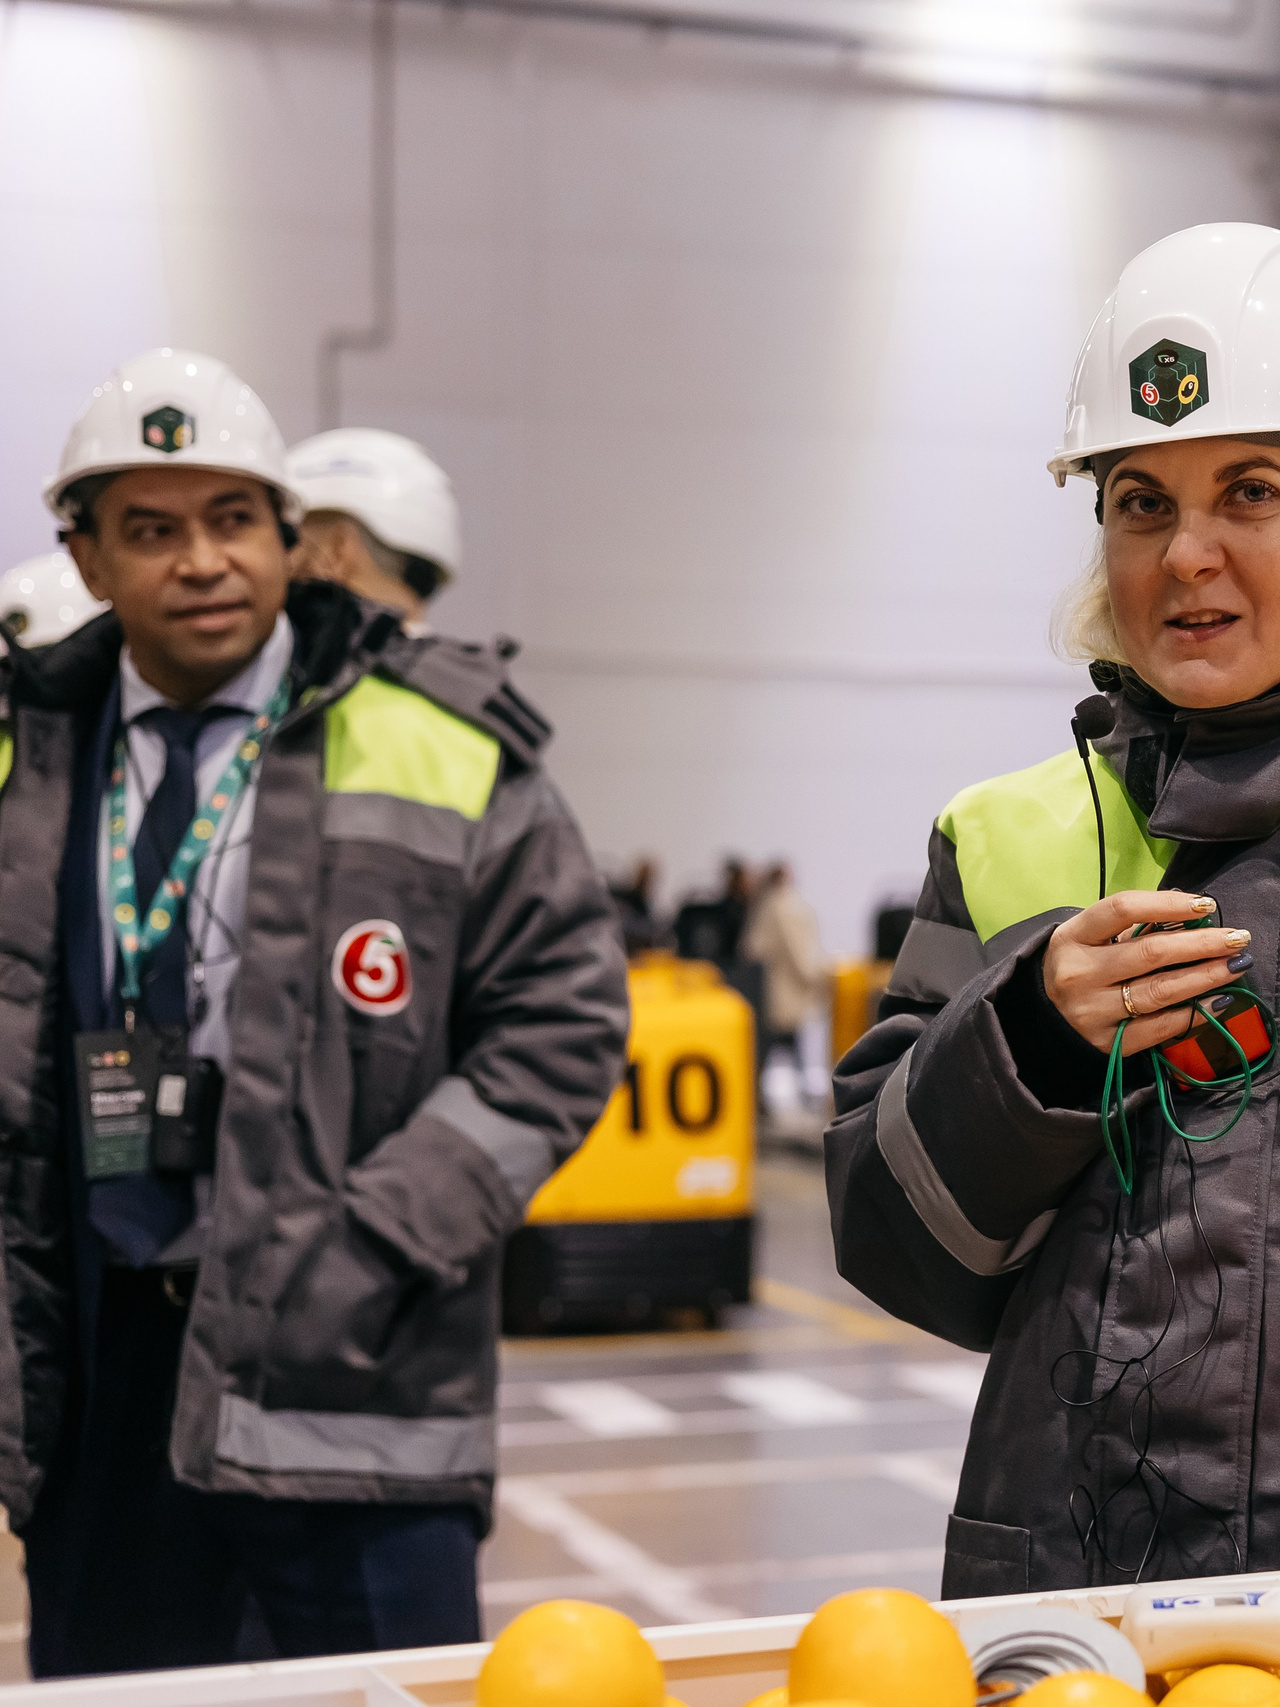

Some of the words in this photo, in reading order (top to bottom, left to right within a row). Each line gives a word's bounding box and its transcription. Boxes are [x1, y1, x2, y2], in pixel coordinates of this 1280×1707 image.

[1144, 383, 1155, 402] 5
[352, 932, 404, 999] 5
[625, 1055, 722, 1136] 10
